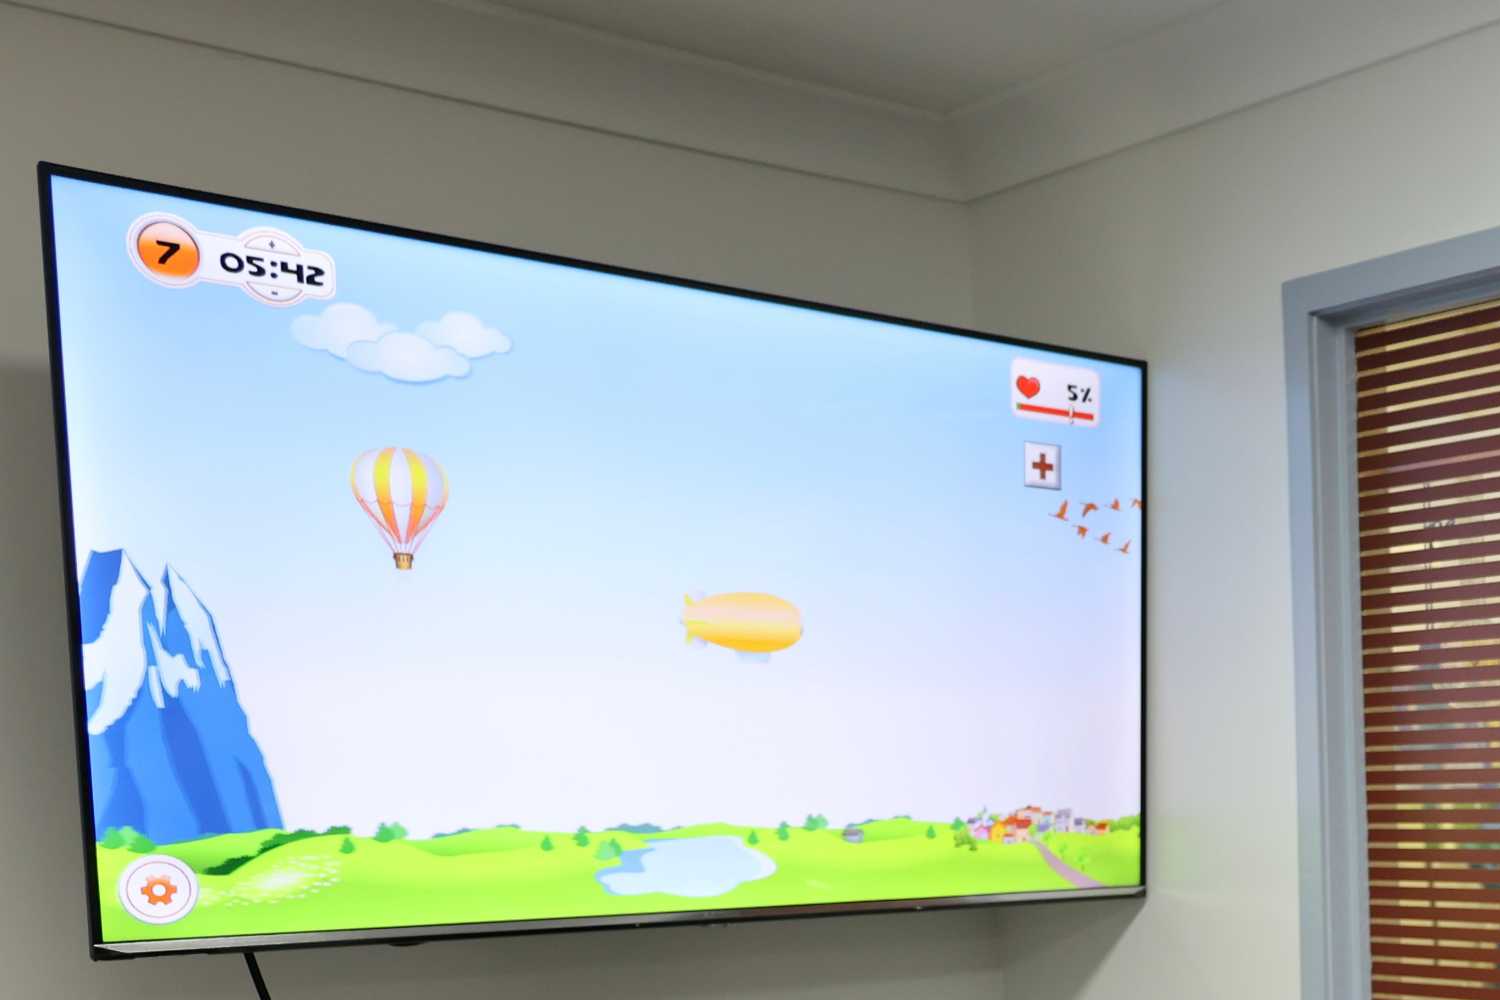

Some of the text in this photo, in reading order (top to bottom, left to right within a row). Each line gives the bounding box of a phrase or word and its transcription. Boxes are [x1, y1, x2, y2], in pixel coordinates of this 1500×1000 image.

[155, 239, 181, 265] 7
[219, 251, 326, 287] 05:42
[1066, 383, 1093, 403] 5%
